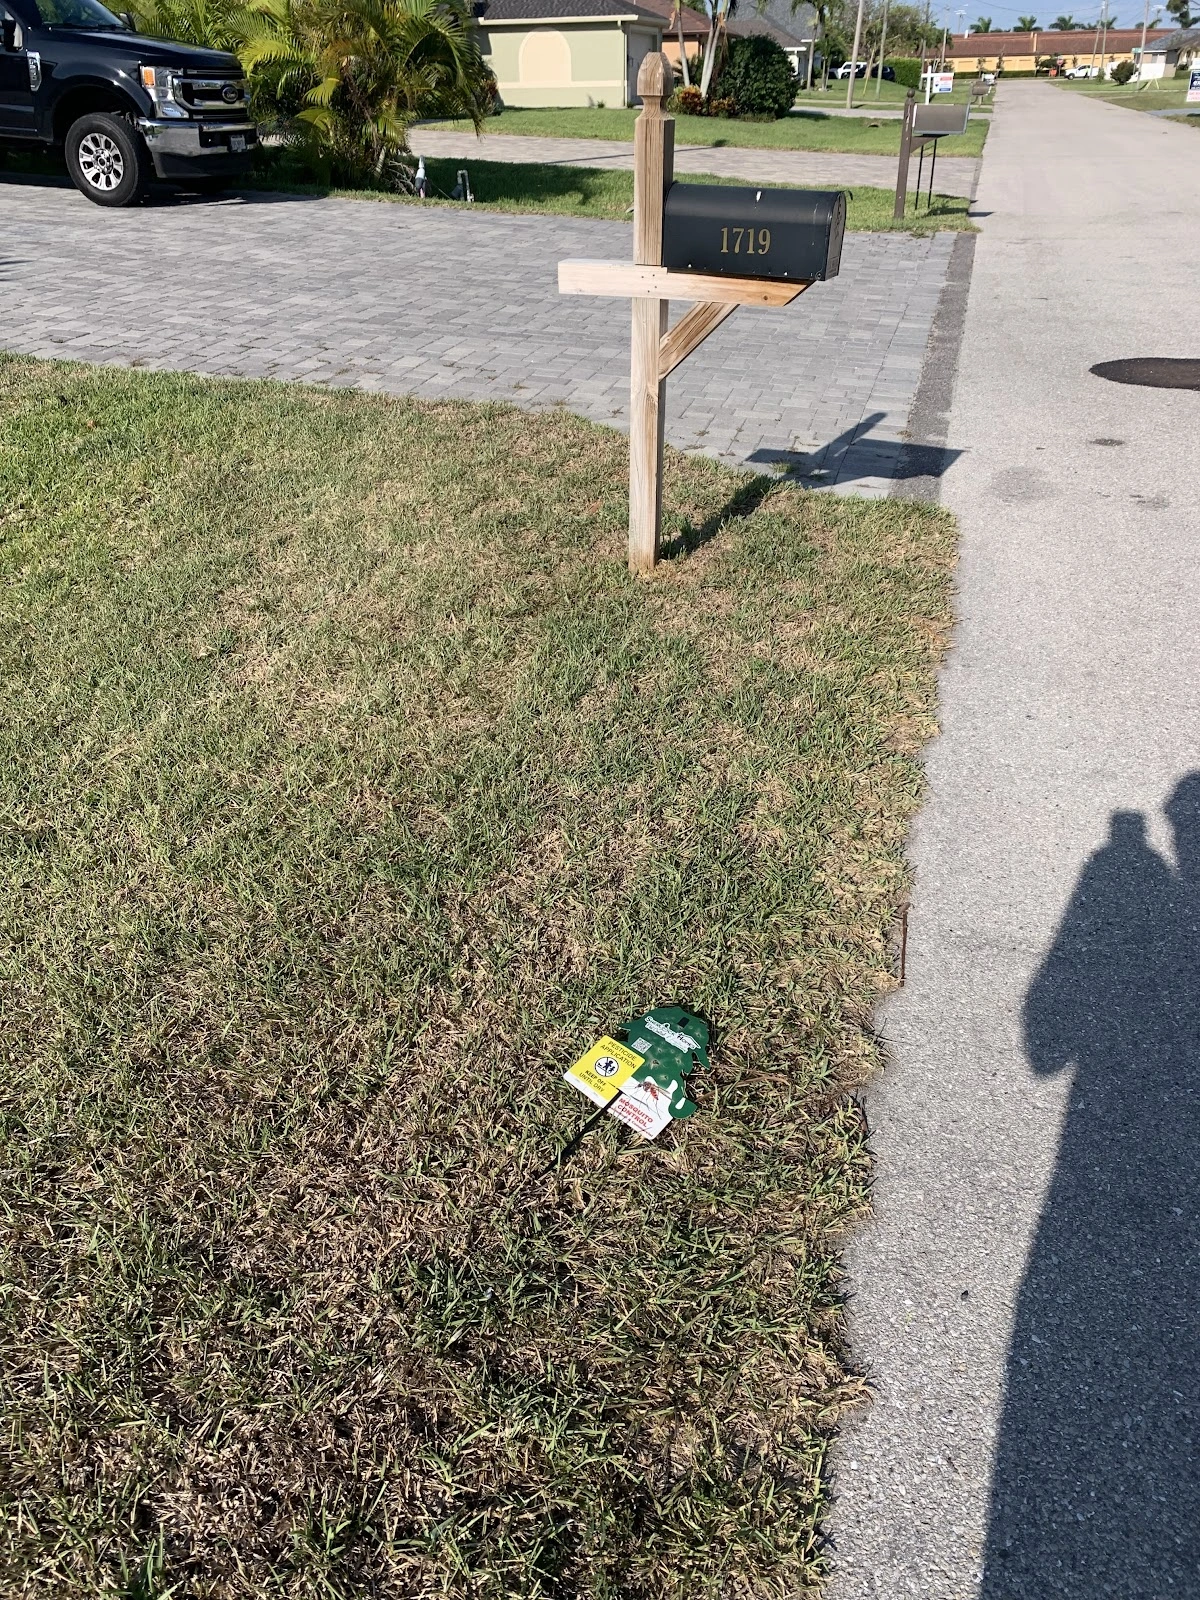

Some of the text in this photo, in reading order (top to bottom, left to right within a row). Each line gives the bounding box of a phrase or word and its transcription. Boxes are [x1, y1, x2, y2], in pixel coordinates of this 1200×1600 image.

[720, 227, 771, 255] 1719
[600, 1044, 637, 1069] APPLICATION
[608, 1041, 637, 1061] PESTICIDE
[579, 1073, 592, 1084] UNTIL
[593, 1083, 605, 1092] DRY
[585, 1070, 597, 1080] KEEP
[617, 1104, 648, 1127] CONTROL
[618, 1098, 654, 1123] MOSQUITO
